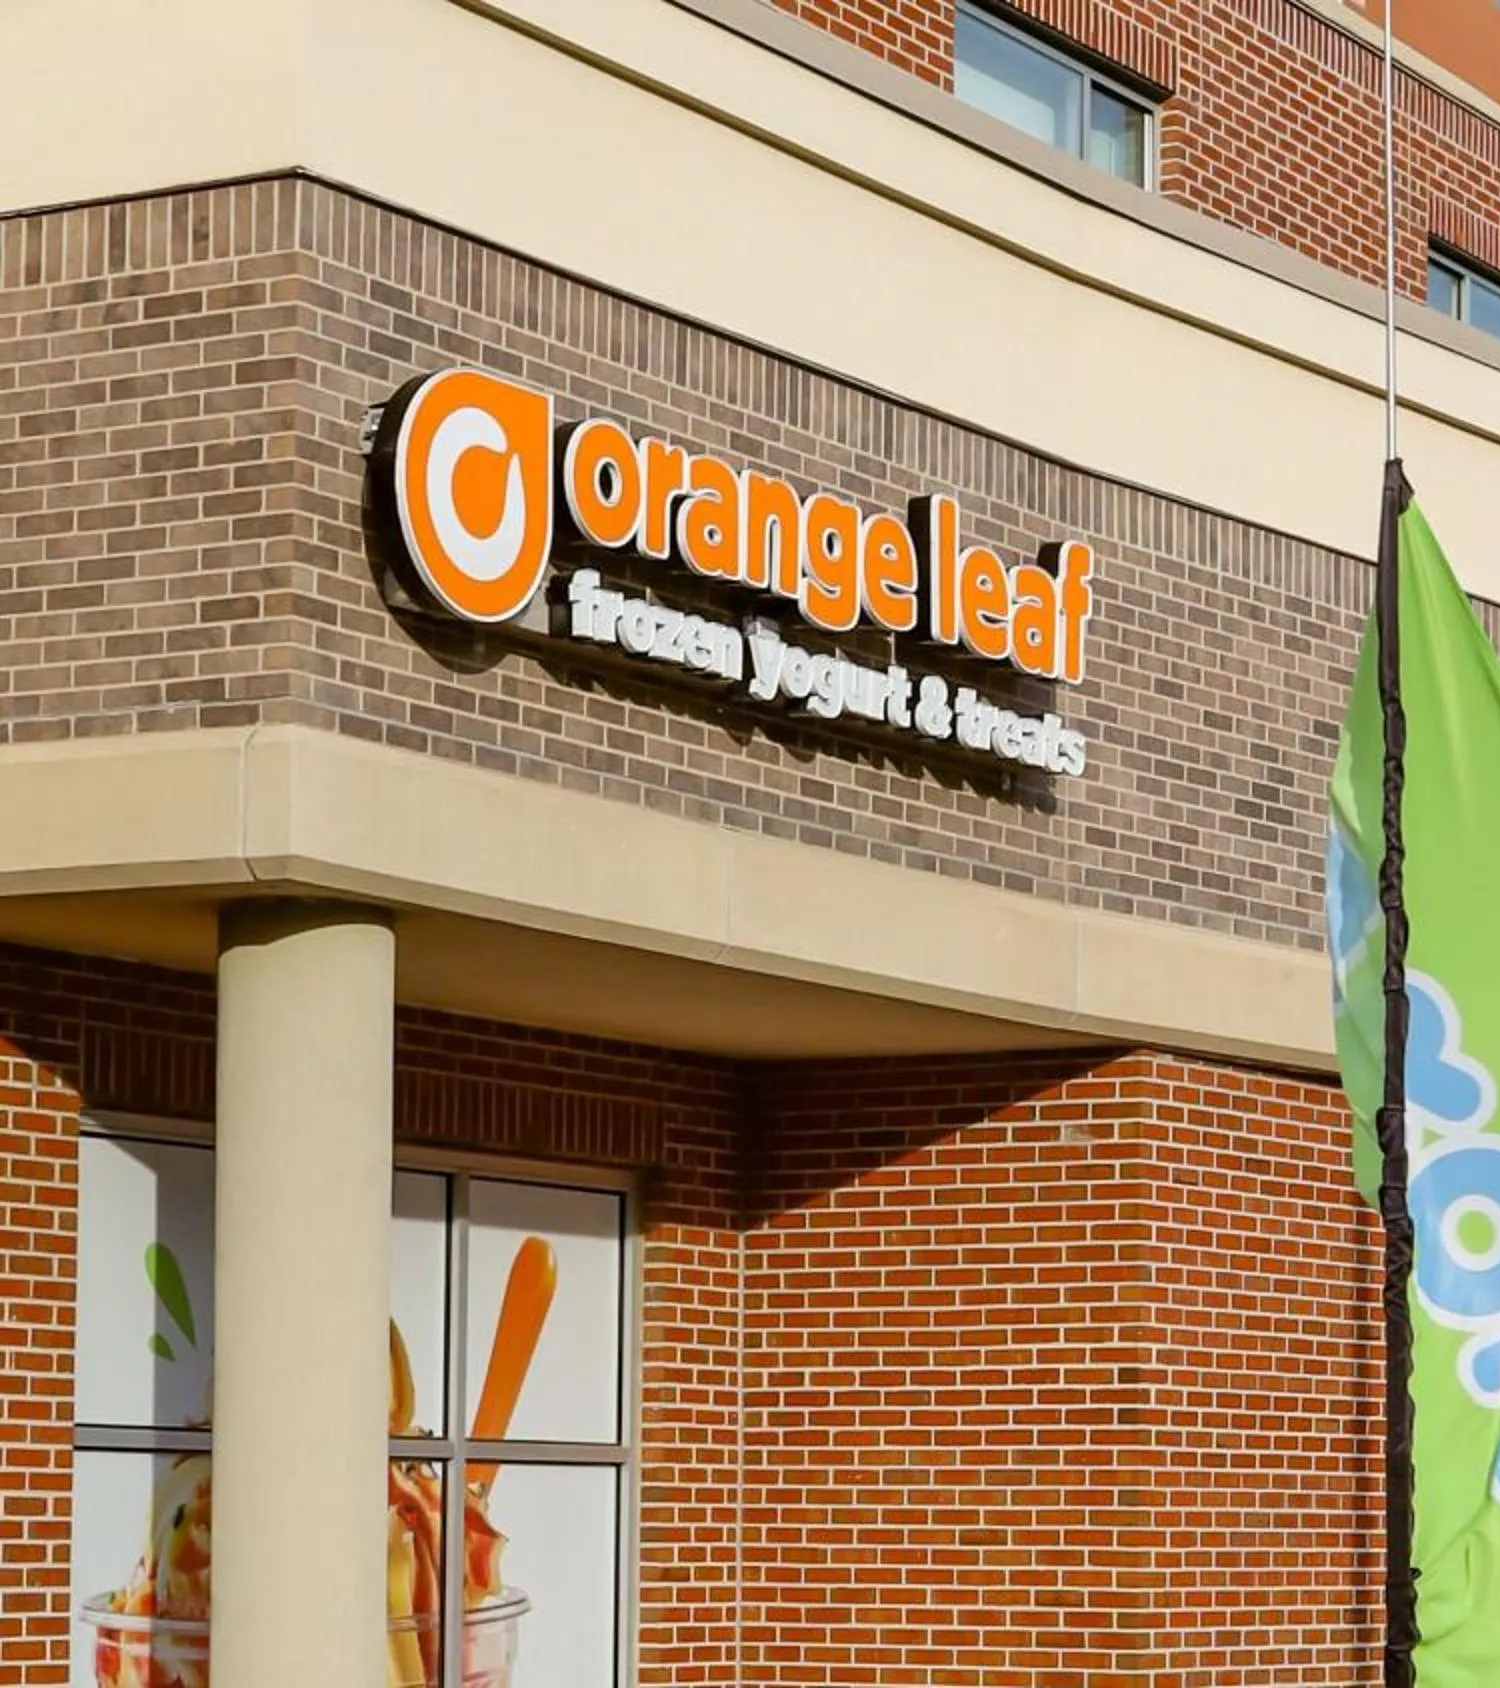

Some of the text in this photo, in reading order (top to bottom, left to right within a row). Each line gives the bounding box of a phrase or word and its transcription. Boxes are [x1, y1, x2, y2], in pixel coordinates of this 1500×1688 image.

[563, 417, 1094, 685] orange leaf
[568, 568, 1087, 777] frozen yogurt & treats
